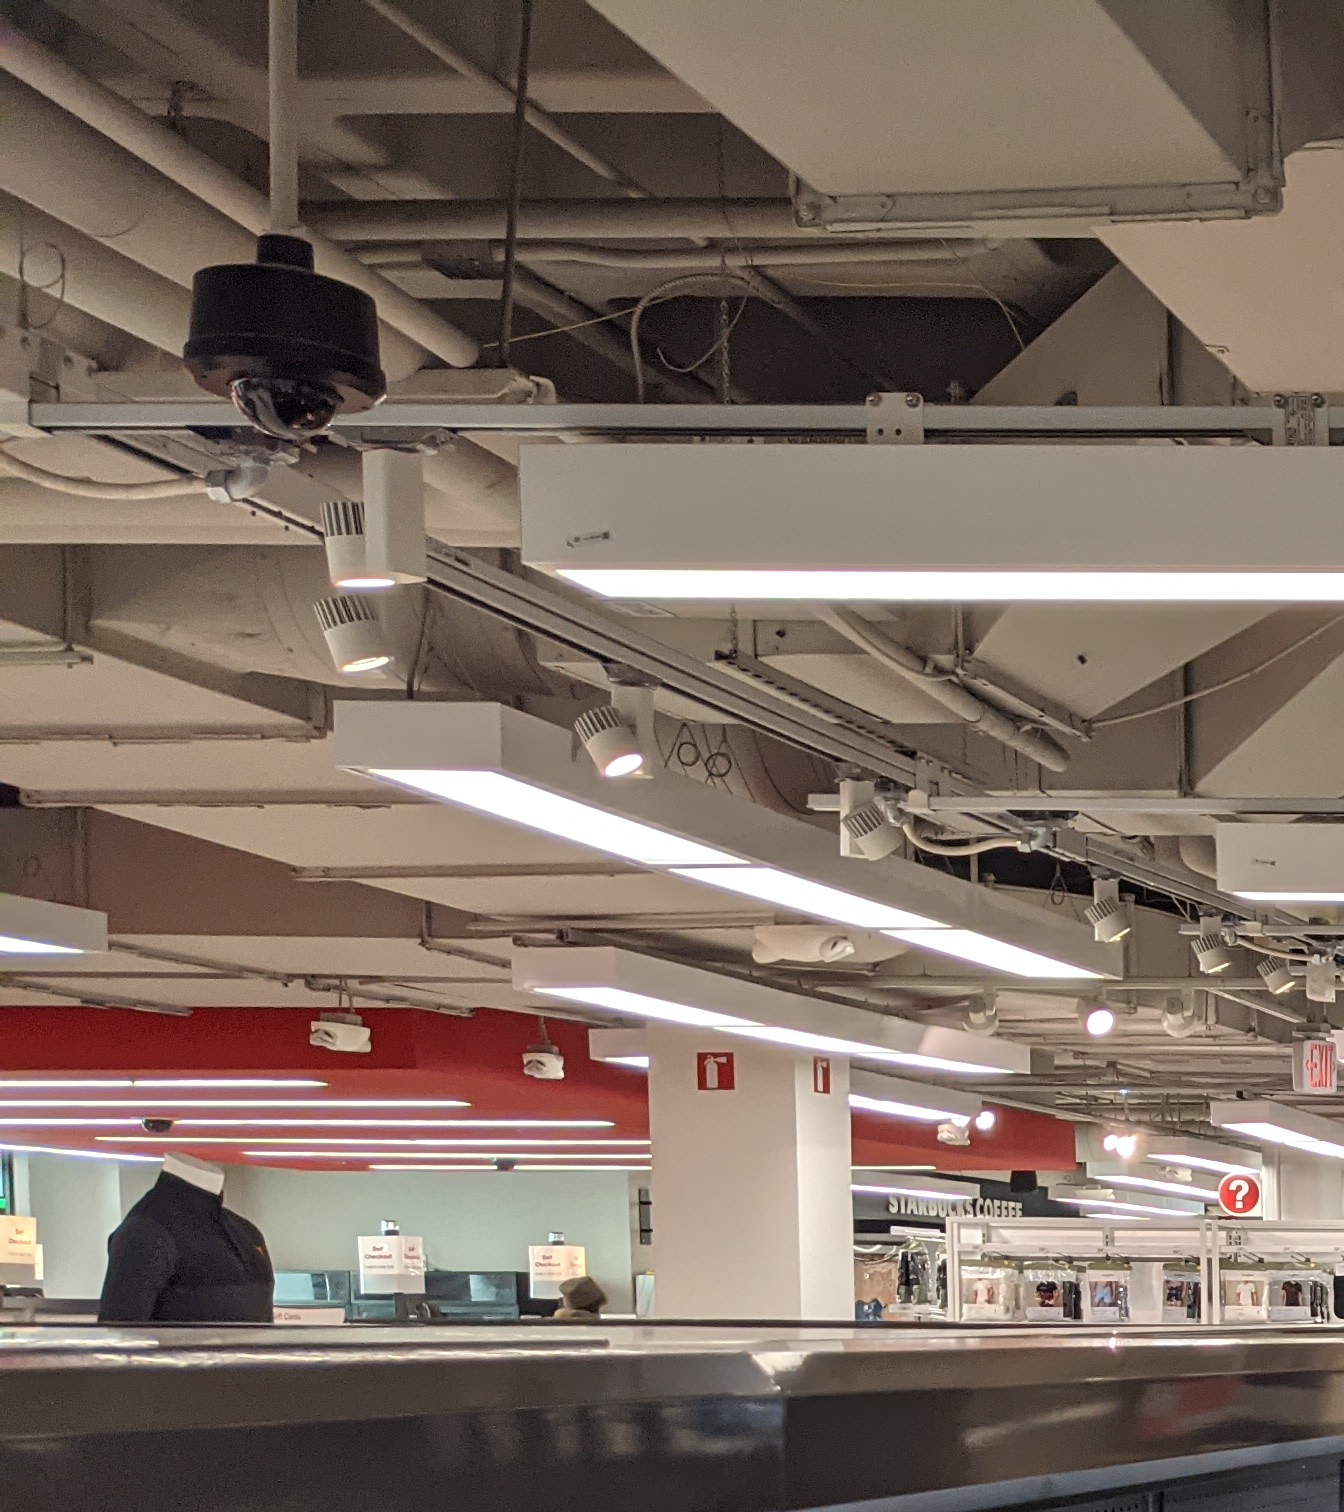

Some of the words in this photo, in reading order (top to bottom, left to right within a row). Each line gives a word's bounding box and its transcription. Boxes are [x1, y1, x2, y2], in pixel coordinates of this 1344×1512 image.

[1310, 1044, 1334, 1088] EXIT
[888, 1195, 974, 1218] STARBUCKS
[975, 1198, 1023, 1218] COFFEE
